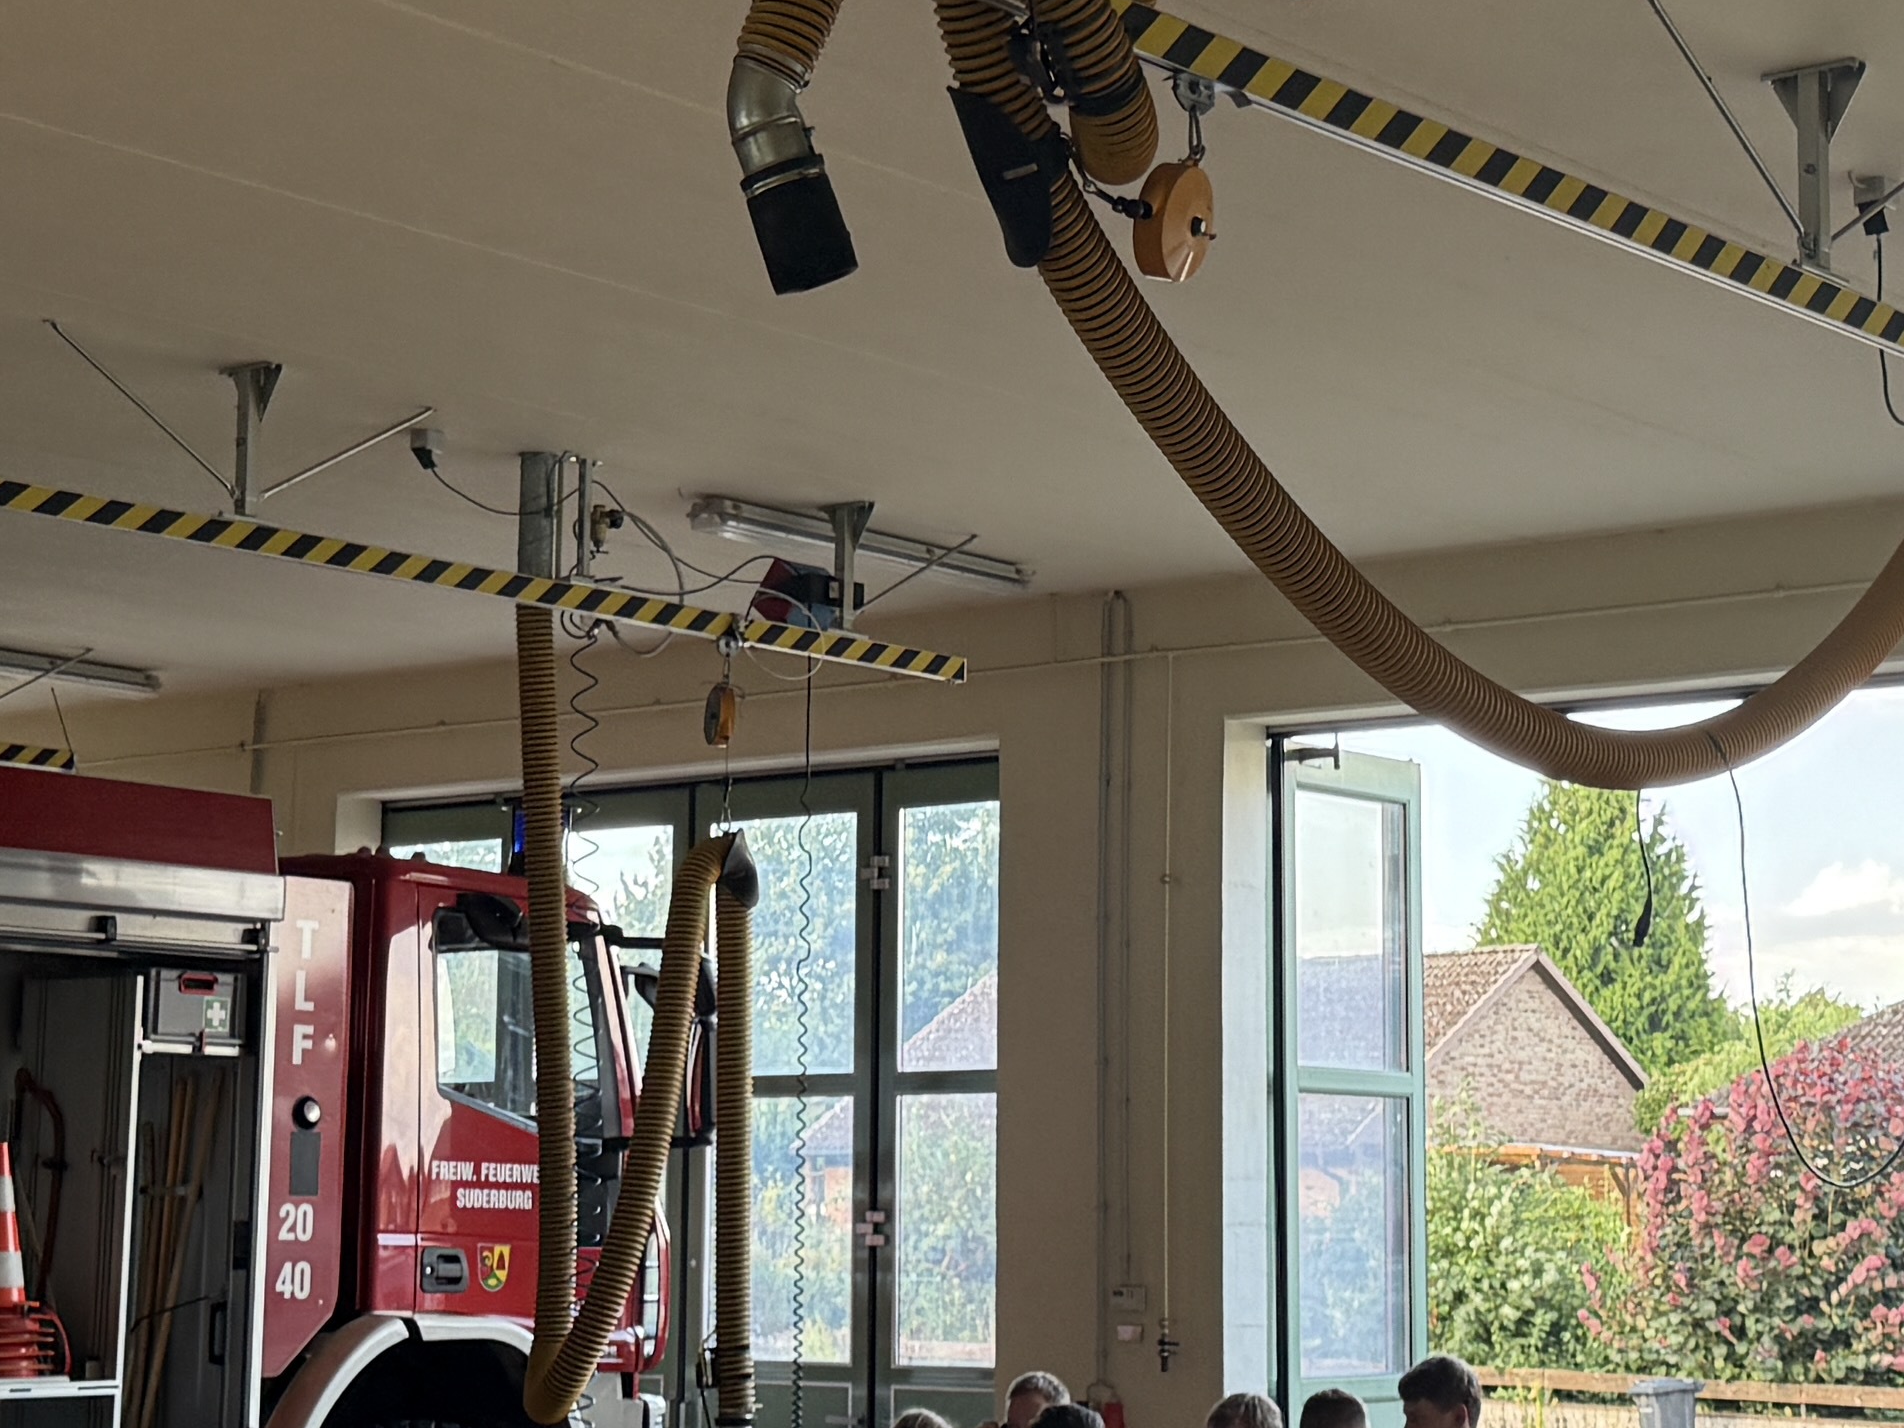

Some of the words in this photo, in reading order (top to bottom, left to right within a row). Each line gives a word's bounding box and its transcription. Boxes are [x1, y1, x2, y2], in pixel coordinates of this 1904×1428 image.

[431, 1159, 477, 1181] FREIW.
[481, 1161, 540, 1184] FEUERWE
[456, 1188, 533, 1210] SUDERBURG
[278, 1203, 314, 1242] 20
[275, 1261, 311, 1301] 40
